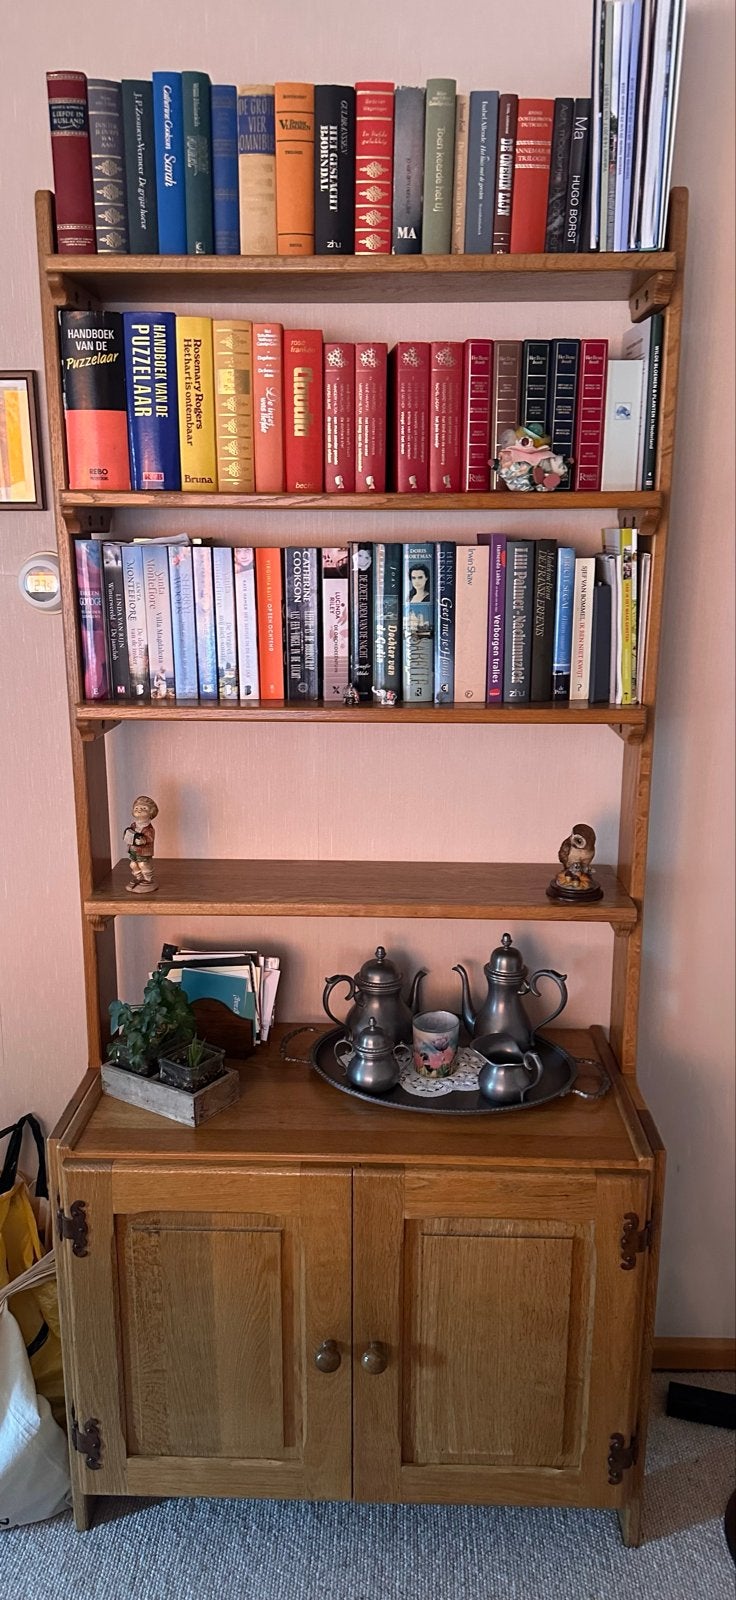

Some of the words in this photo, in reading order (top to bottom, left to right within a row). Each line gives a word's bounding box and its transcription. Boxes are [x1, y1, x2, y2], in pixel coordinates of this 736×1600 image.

[248, 116, 266, 132] VIER
[574, 116, 588, 140] Ma
[240, 134, 274, 150] OMNIBU
[329, 125, 338, 150] HET
[436, 126, 446, 149] Toen
[500, 138, 513, 152] DE
[164, 154, 176, 186] Sarah
[329, 152, 338, 212] GESLACHT
[570, 175, 580, 206] HUGO
[497, 192, 510, 216] LIJN
[396, 226, 416, 239] MA
[568, 209, 578, 244] BORST
[68, 329, 114, 339] HANDBOEK
[76, 341, 93, 351] VAN
[96, 342, 108, 351] DE
[153, 325, 168, 382] HANDBOEK
[184, 339, 192, 357] Het
[66, 352, 119, 370] Puzzelaar
[132, 324, 152, 417] PUZZELAAR
[184, 358, 192, 381] hart
[193, 339, 202, 392] Rosemary
[155, 383, 168, 405] VAN
[185, 382, 193, 390] is
[156, 406, 168, 418] DE
[186, 392, 194, 446] ontembaar
[194, 393, 203, 430] Rogers
[184, 475, 213, 484] Bruna
[467, 548, 476, 565] Irwin
[514, 548, 528, 570] Lilli
[146, 558, 157, 610] Montefiore
[155, 571, 166, 595] Santa
[293, 551, 302, 602] COOKSON
[302, 551, 310, 602] CATHERINE
[467, 566, 476, 585] Shaw
[126, 560, 137, 622] MONTEFIORE
[513, 572, 527, 610] Palmer
[440, 597, 453, 622] Geef
[387, 625, 397, 658] Dochter
[442, 623, 449, 636] me
[492, 615, 501, 656] Verborgen
[512, 615, 526, 684] Nachtmuziek
[492, 658, 500, 683] tralies
